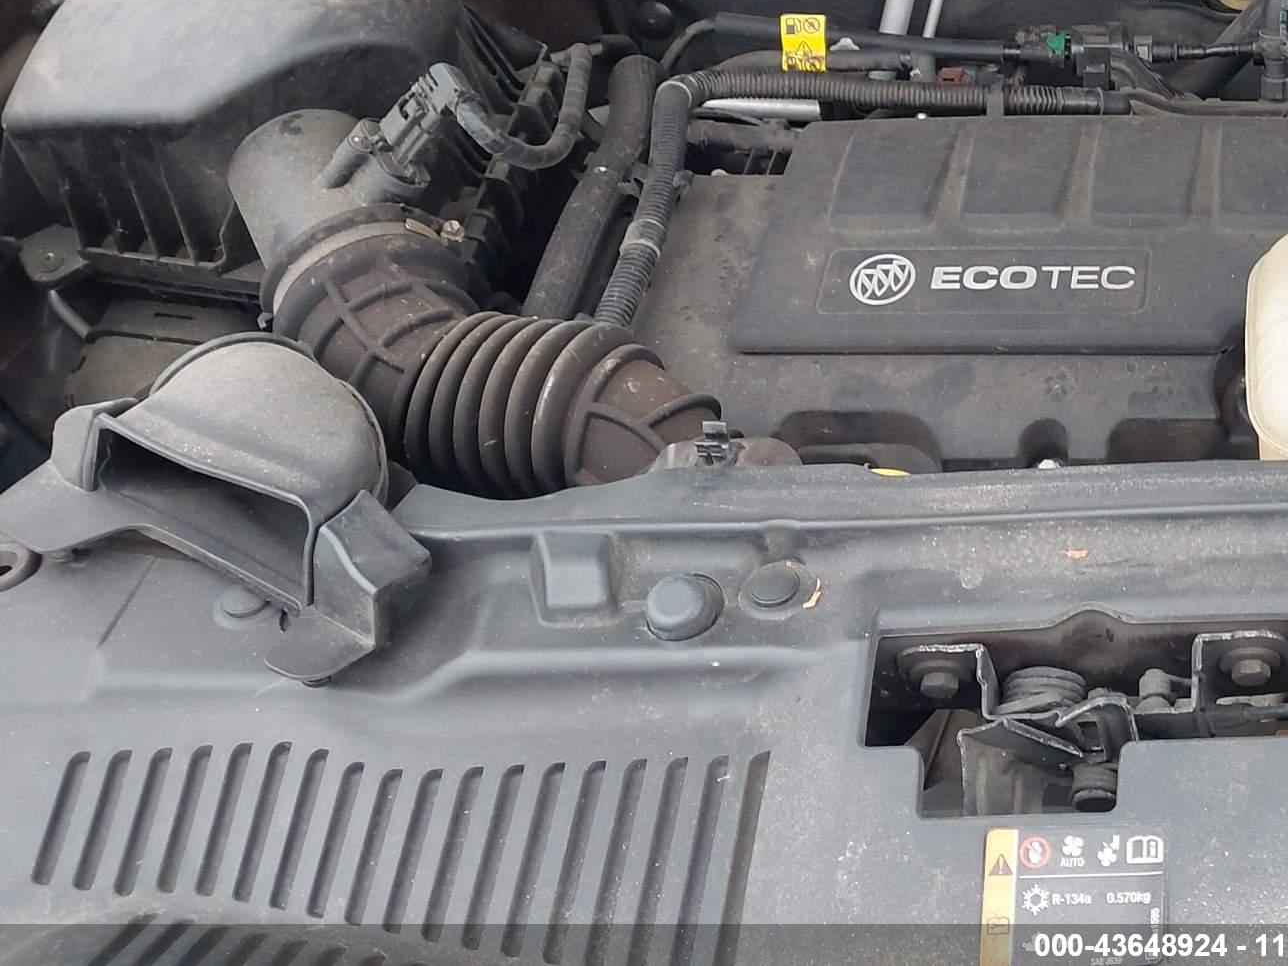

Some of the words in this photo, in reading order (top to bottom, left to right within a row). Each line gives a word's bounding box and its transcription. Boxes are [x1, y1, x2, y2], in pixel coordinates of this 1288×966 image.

[930, 265, 1135, 290] ECOTEC
[1060, 857, 1084, 868] AUTO
[1051, 892, 1092, 905] R-134a
[1106, 891, 1151, 905] 0.570kg
